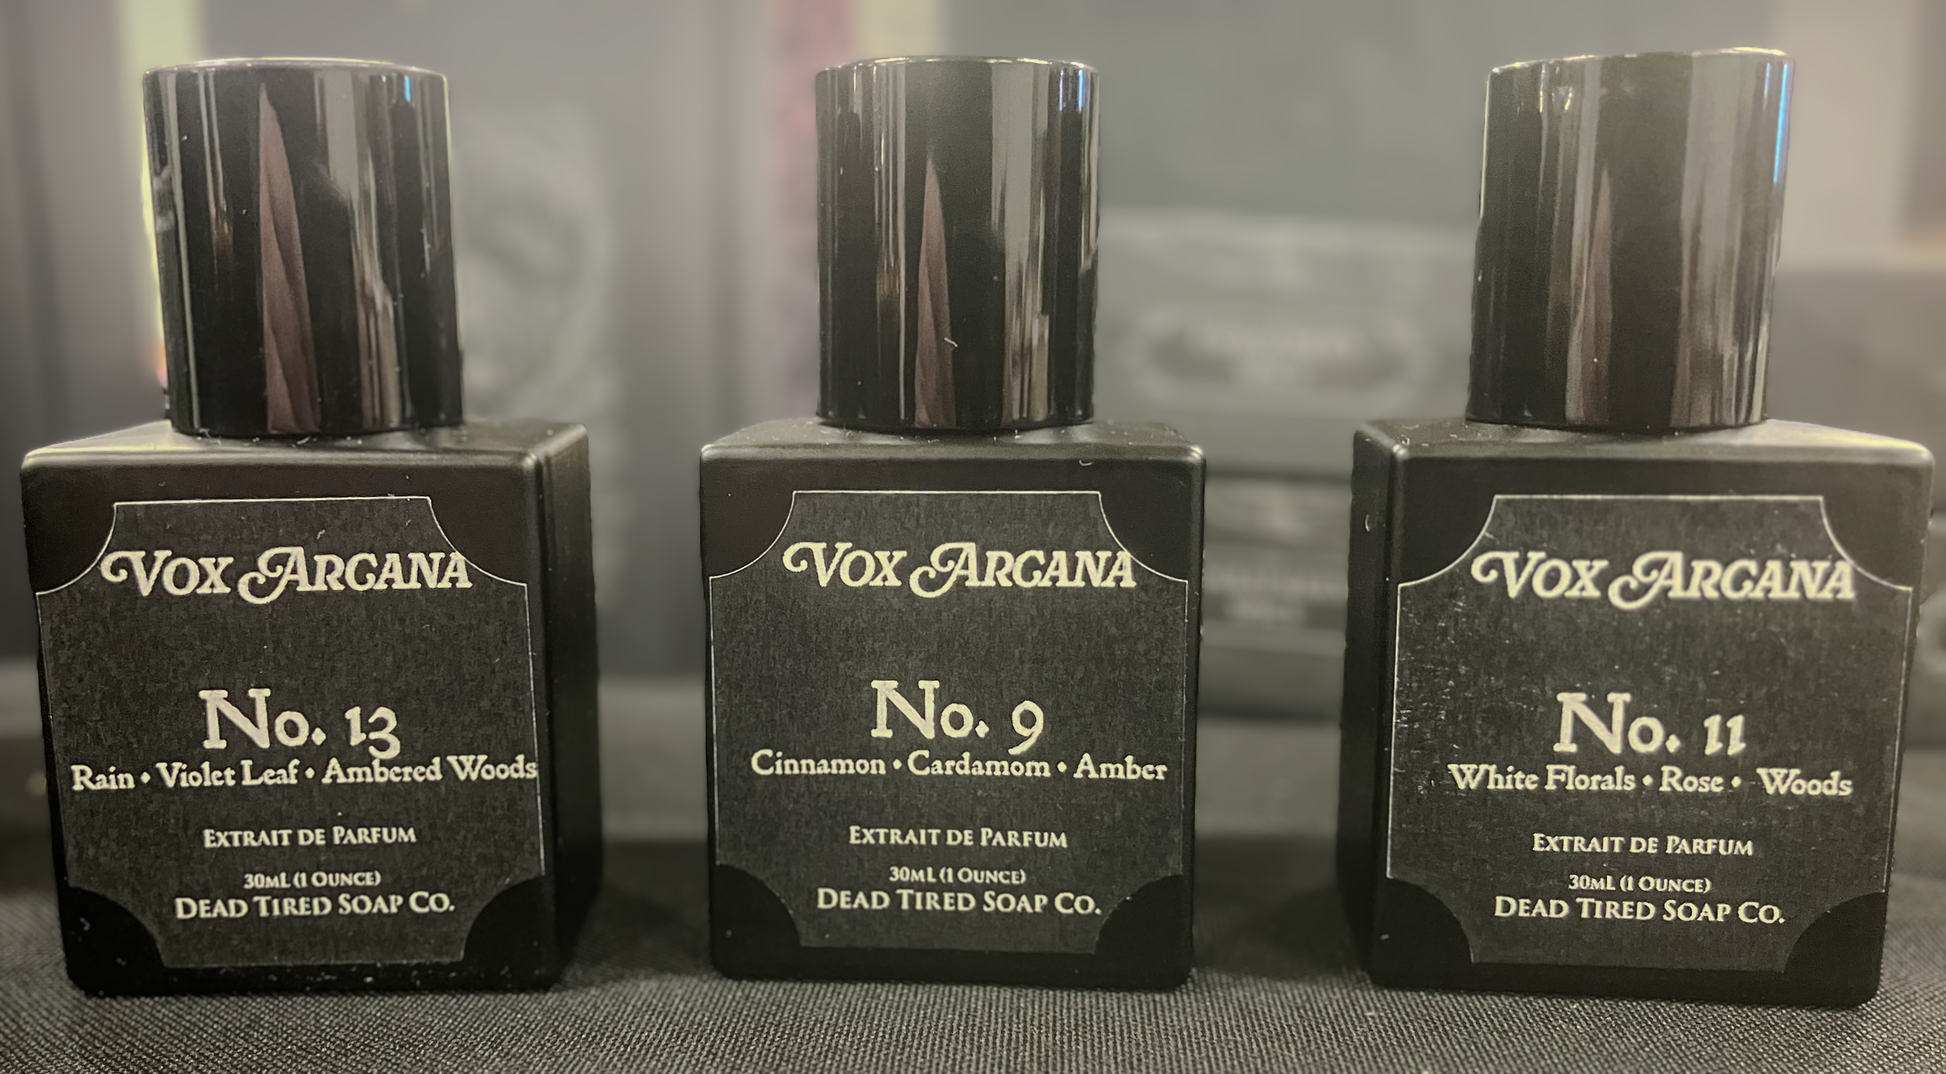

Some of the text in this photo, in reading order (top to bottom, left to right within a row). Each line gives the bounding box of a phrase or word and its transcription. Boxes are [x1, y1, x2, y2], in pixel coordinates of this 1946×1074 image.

[198, 687, 401, 760] No. 13
[870, 679, 1045, 756] No. 9
[1552, 691, 1747, 757] No. 11
[70, 753, 539, 791] Rain Violet Leaf Ambered Woods
[750, 748, 1168, 781] Cinnamon Cardamom Amber
[1446, 763, 1854, 797] White Florals Rose Woods
